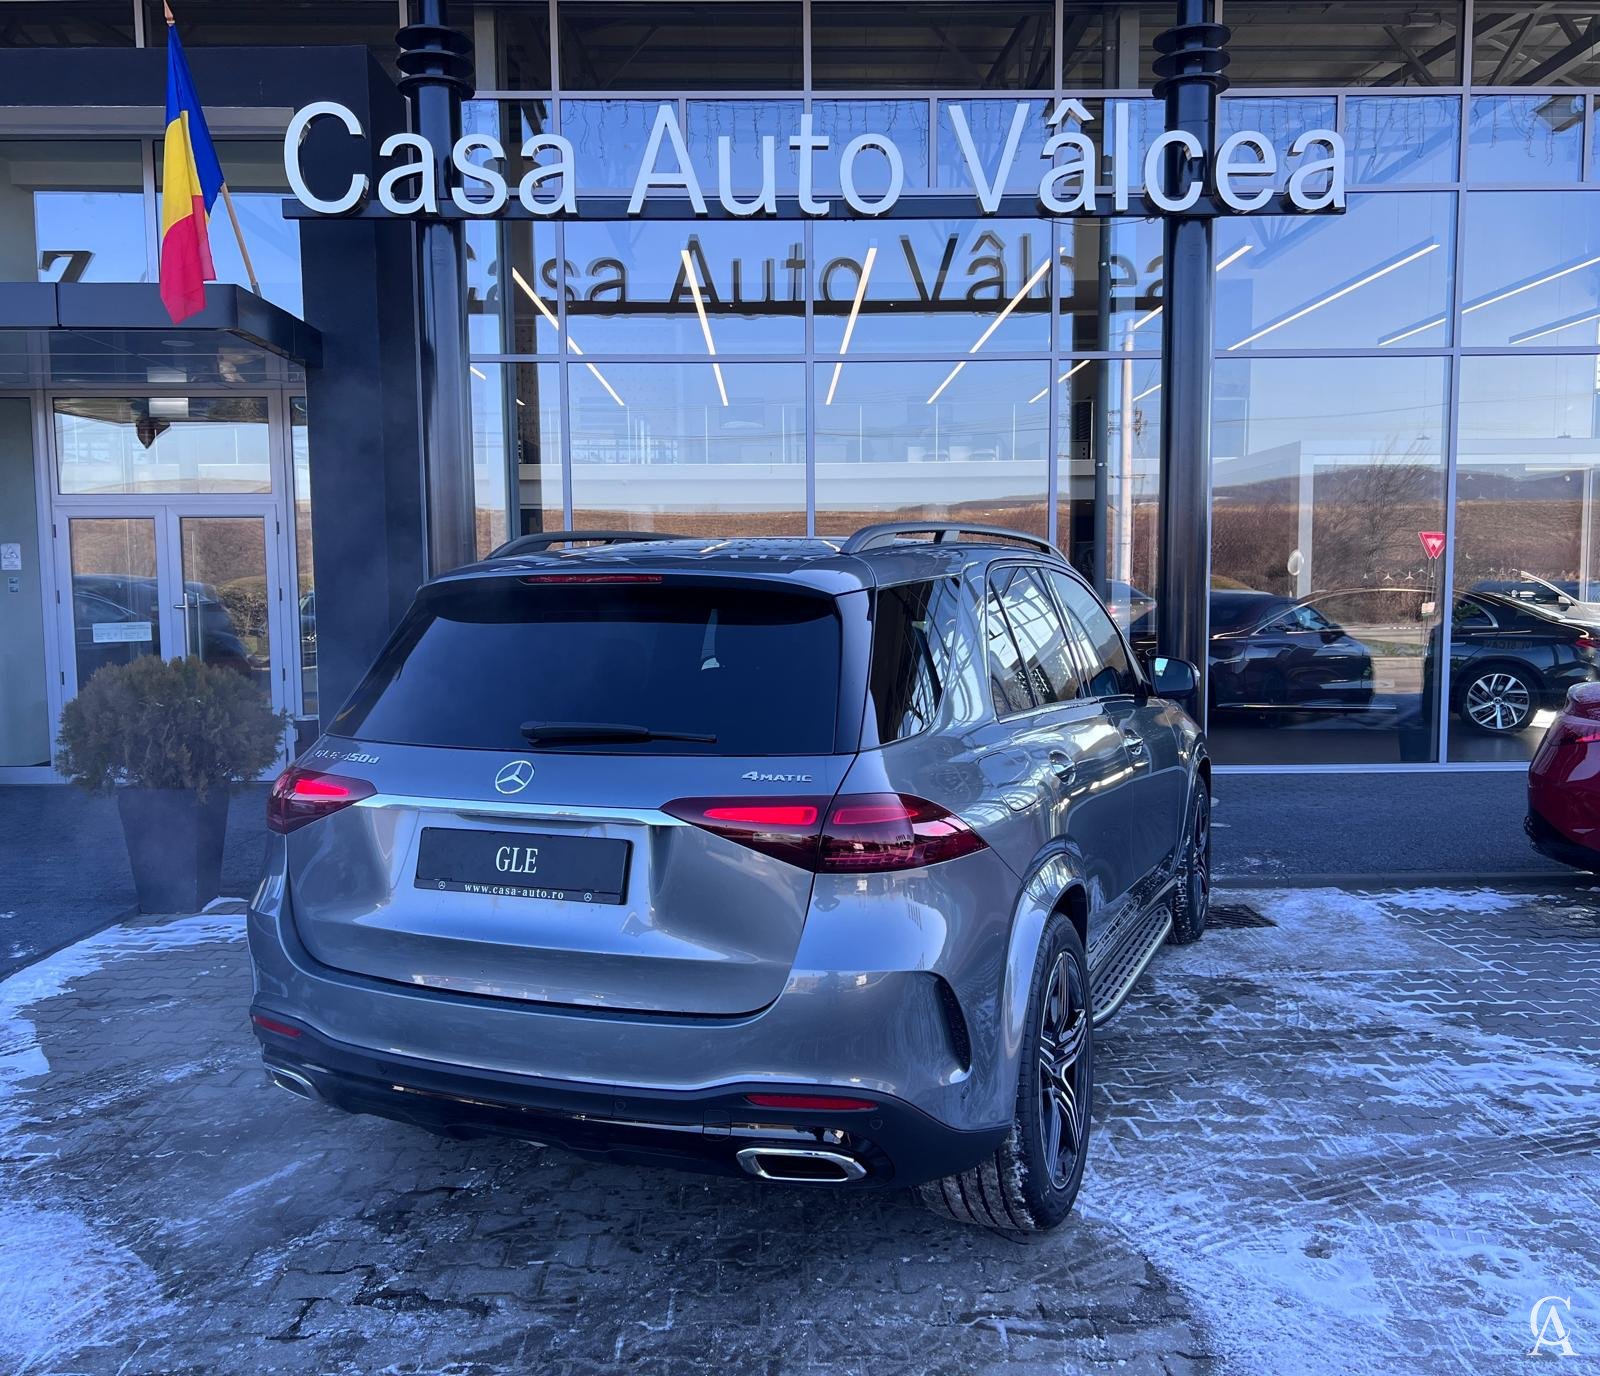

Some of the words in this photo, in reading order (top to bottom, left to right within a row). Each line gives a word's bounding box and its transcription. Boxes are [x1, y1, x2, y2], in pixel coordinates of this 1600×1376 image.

[283, 100, 578, 216] Casa
[627, 103, 904, 216] Auto
[948, 98, 1347, 215] Vâlcea
[741, 770, 813, 783] 4MATIC
[495, 846, 539, 874] GLE
[464, 883, 564, 900] www.casa-auto.ro
